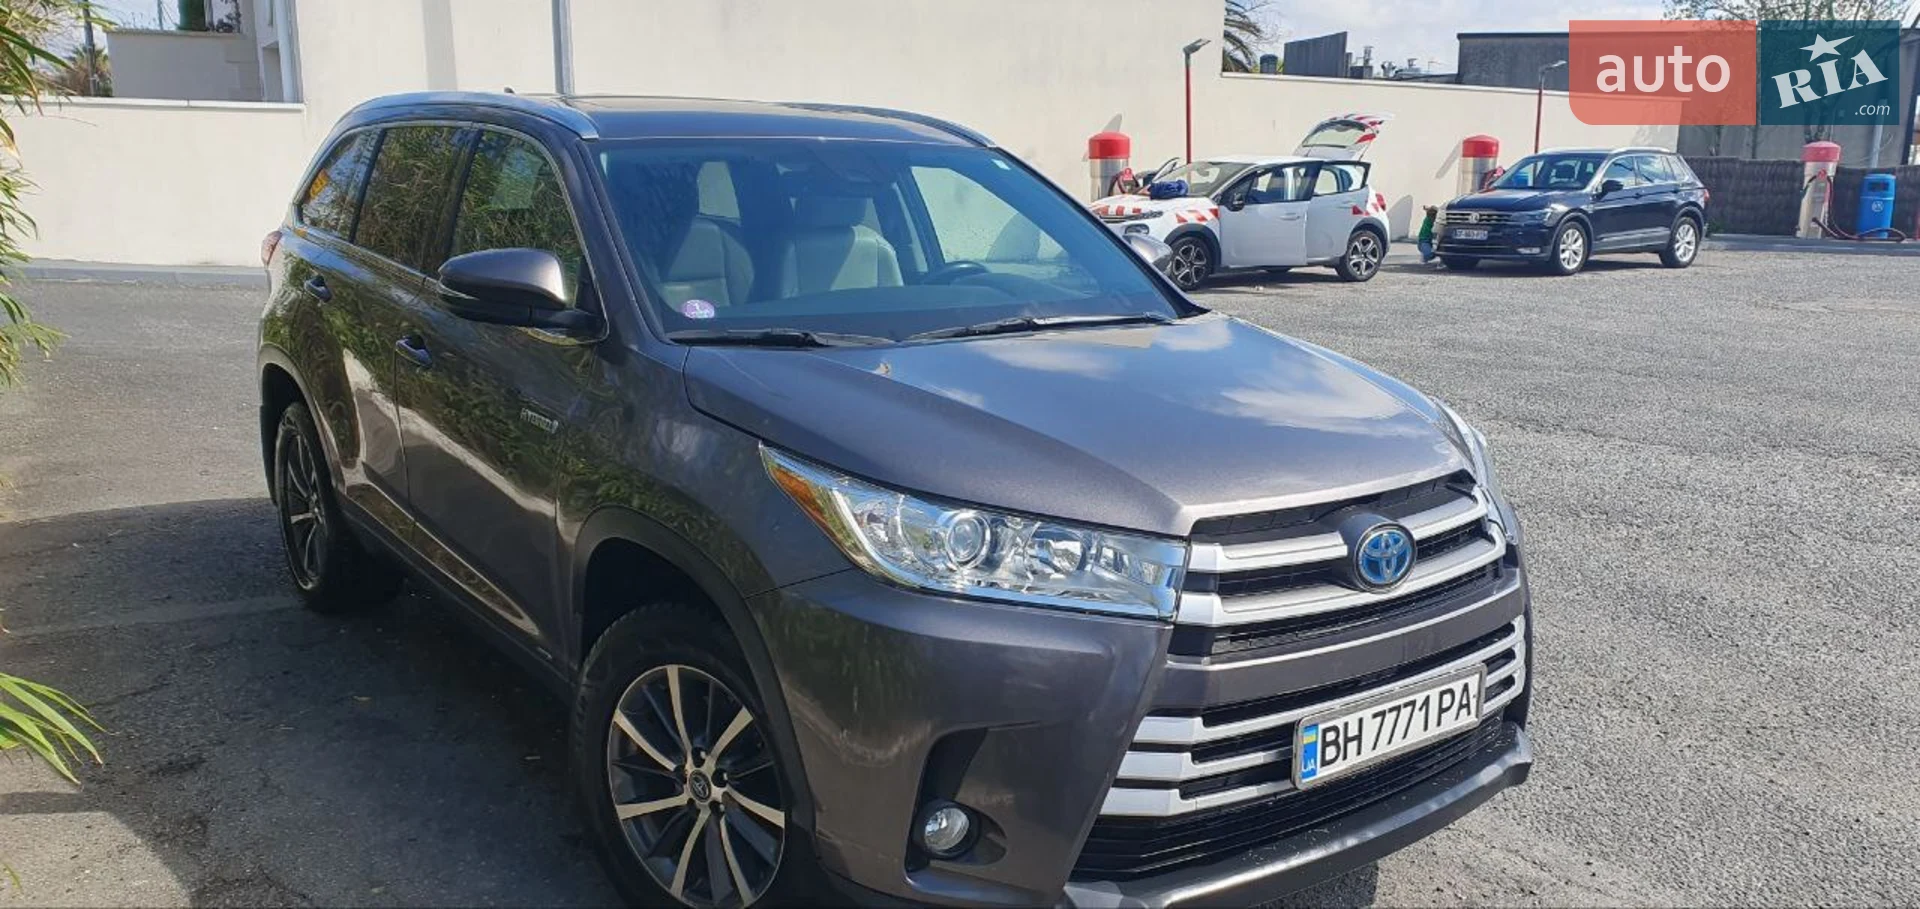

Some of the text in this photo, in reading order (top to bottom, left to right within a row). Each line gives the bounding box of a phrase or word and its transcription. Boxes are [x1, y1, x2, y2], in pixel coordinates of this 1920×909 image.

[1320, 682, 1472, 769] BH 7771 PA
[1302, 757, 1316, 772] UA
